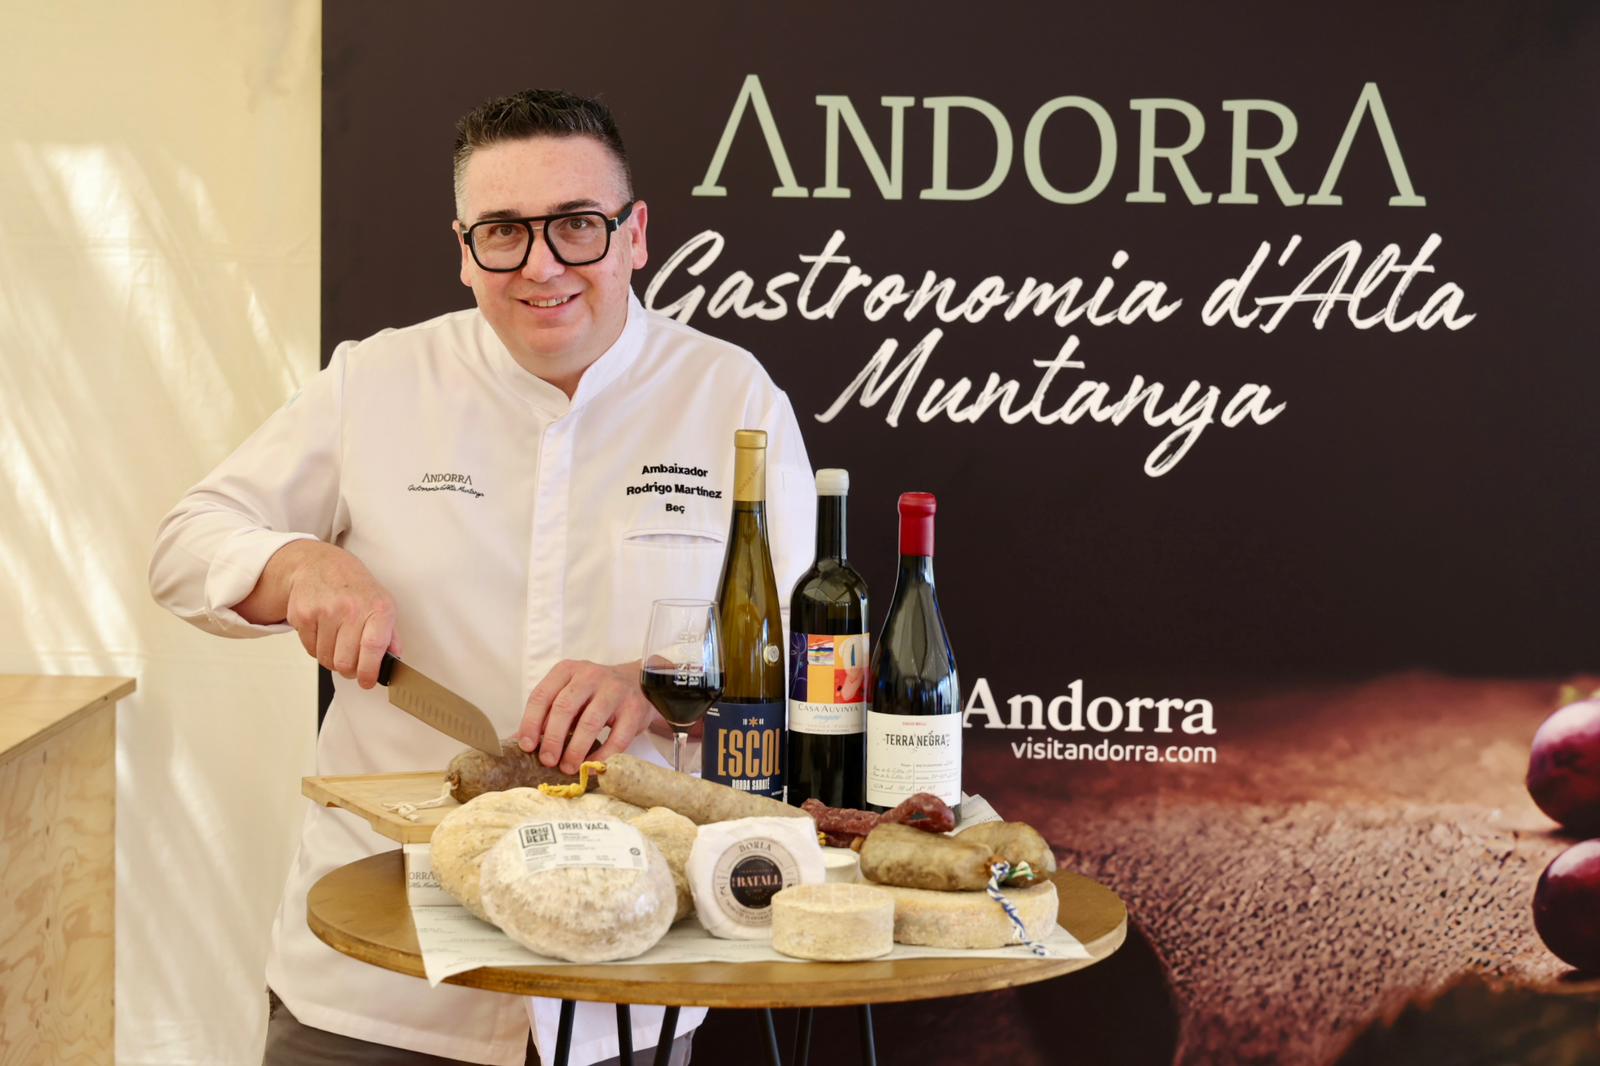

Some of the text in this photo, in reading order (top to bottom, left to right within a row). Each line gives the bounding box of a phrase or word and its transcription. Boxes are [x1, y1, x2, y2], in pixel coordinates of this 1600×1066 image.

[691, 74, 1427, 207] ANDORRA
[644, 229, 1477, 334] Gastronomia d'Alta
[814, 328, 1287, 478] Muntanya
[421, 473, 473, 485] ANDORRA
[641, 463, 709, 478] Ambaixador
[626, 481, 673, 496] Rodrigo
[675, 482, 722, 499] Martínez
[665, 503, 685, 514] Beç
[961, 677, 1217, 735] Andorra
[885, 733, 946, 747] TERRA NEGRA
[1011, 737, 1217, 763] visitandorra.com
[717, 728, 781, 778] ESCOL
[585, 822, 610, 831] VACA
